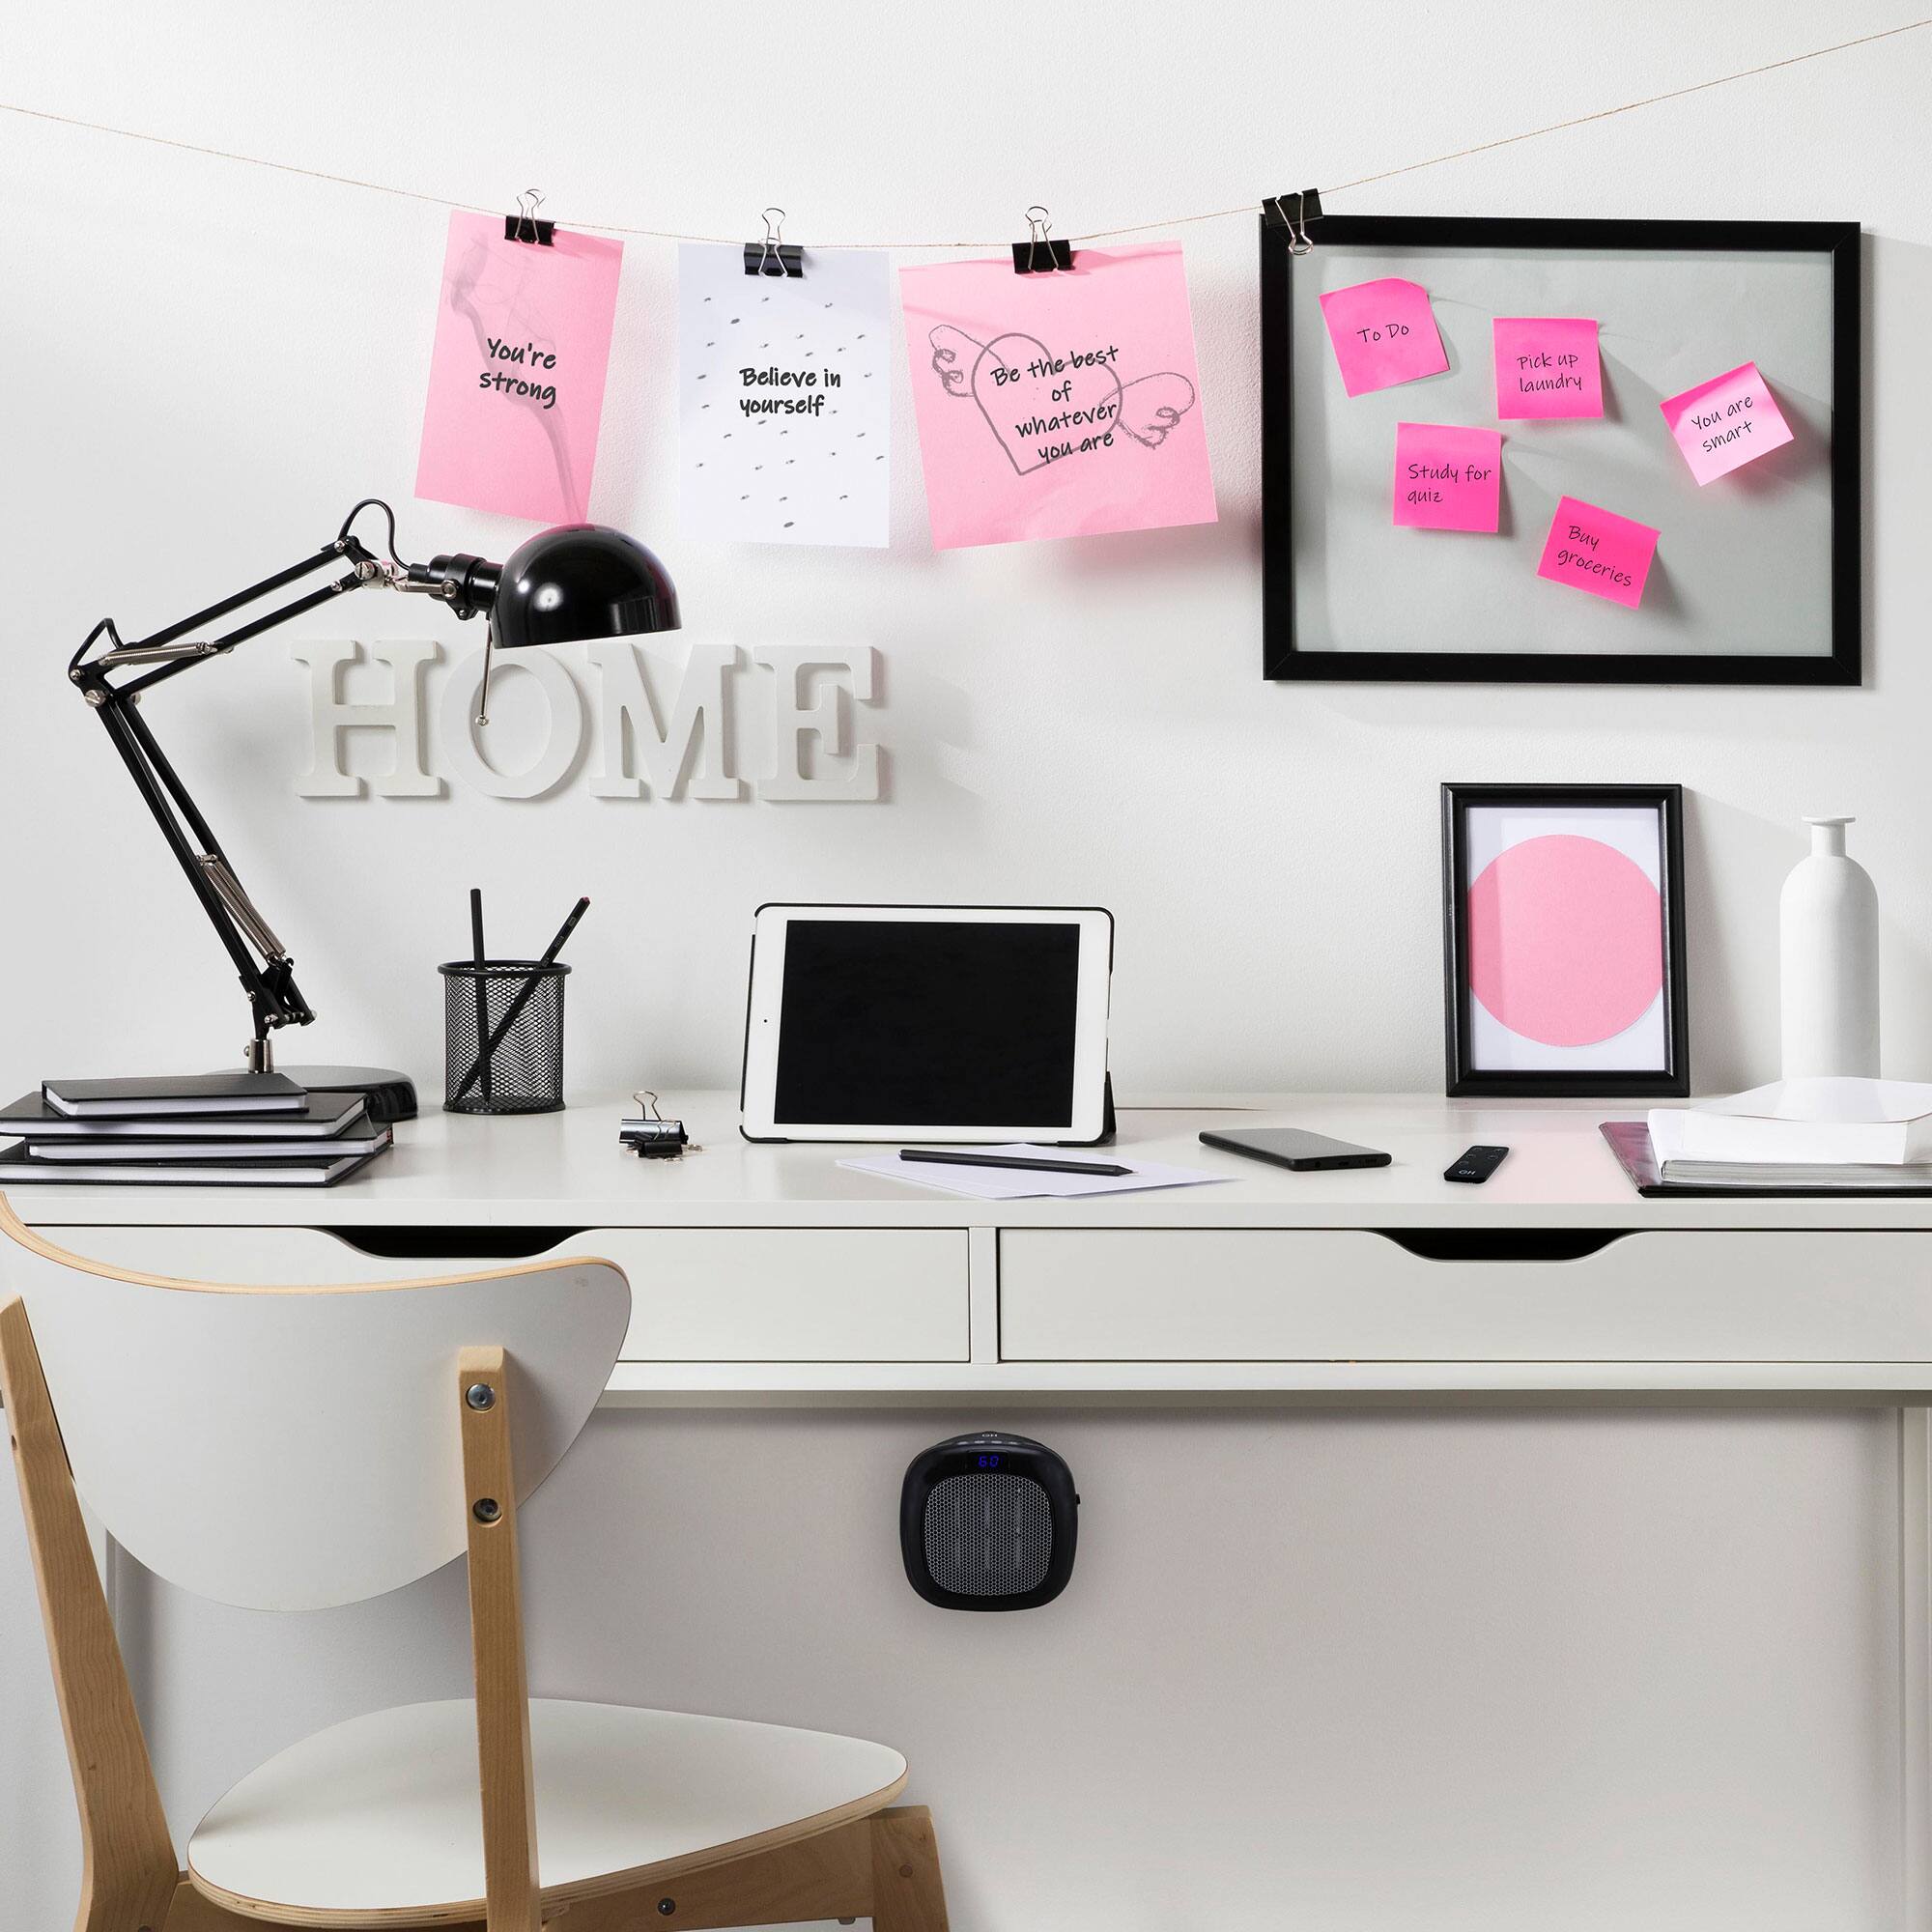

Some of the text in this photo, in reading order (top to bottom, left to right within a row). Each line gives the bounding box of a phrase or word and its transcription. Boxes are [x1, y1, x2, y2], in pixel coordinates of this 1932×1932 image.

[1356, 323, 1409, 344] To Do
[487, 337, 556, 370] You're
[990, 345, 1119, 386] Be the best
[1517, 353, 1579, 371] Pick up
[739, 366, 841, 388] Believe in
[1519, 373, 1582, 393] laundry
[479, 371, 556, 410] strong
[1051, 380, 1072, 402] of
[739, 394, 825, 417] yourself
[1690, 396, 1753, 430] You are
[1014, 403, 1118, 438] whatever
[1037, 433, 1114, 464] you are
[1702, 420, 1752, 452] smart
[1407, 463, 1492, 484] Study for
[1406, 487, 1444, 504] quiz
[1567, 525, 1601, 551] Buy
[1557, 549, 1634, 587] groceries
[292, 639, 880, 801] HOME
[978, 1455, 1000, 1467] 60
